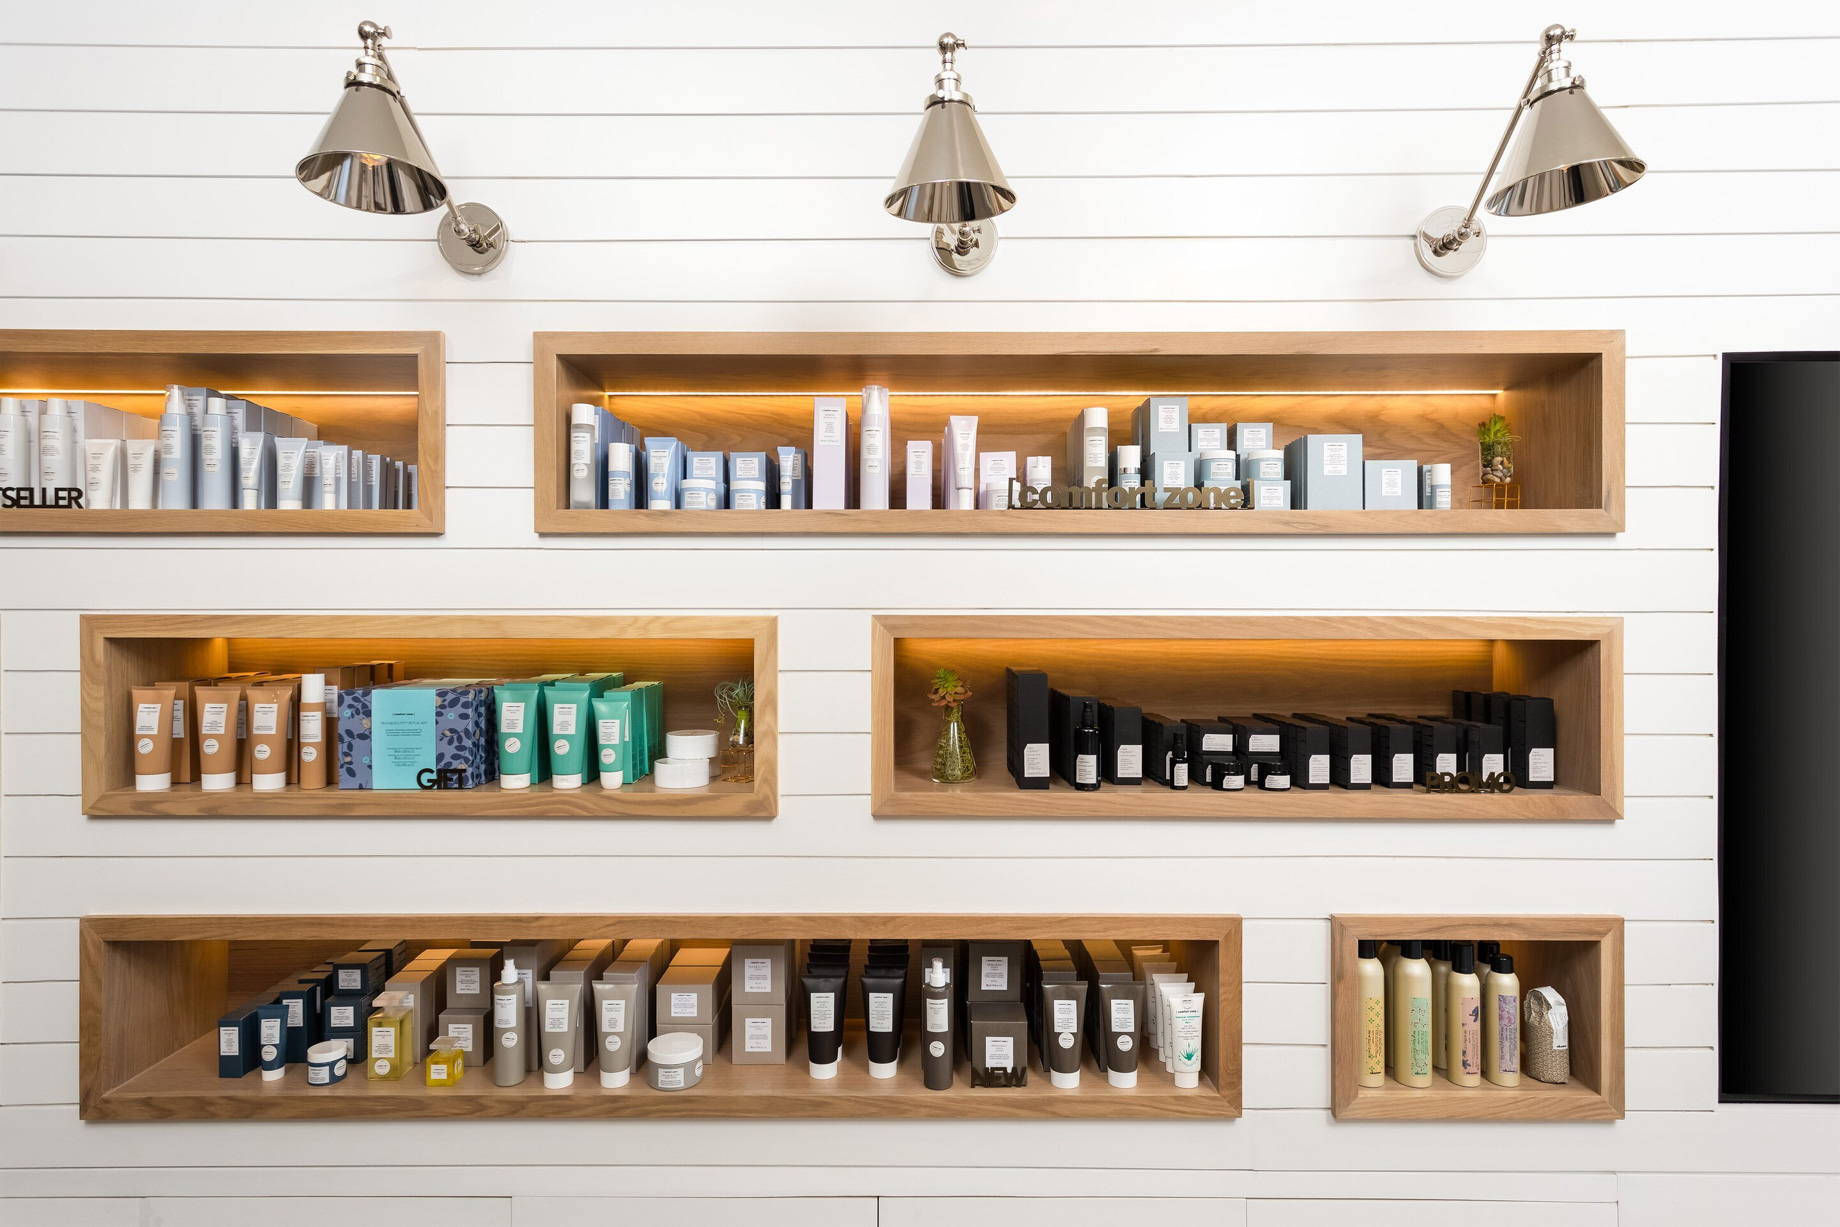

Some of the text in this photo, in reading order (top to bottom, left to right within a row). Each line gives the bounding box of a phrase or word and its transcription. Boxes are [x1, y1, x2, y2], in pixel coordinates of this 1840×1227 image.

[0, 486, 84, 509] SELLER
[416, 768, 467, 790] GIFT
[1426, 771, 1516, 794] PROMO
[971, 1066, 1027, 1088] NEW
